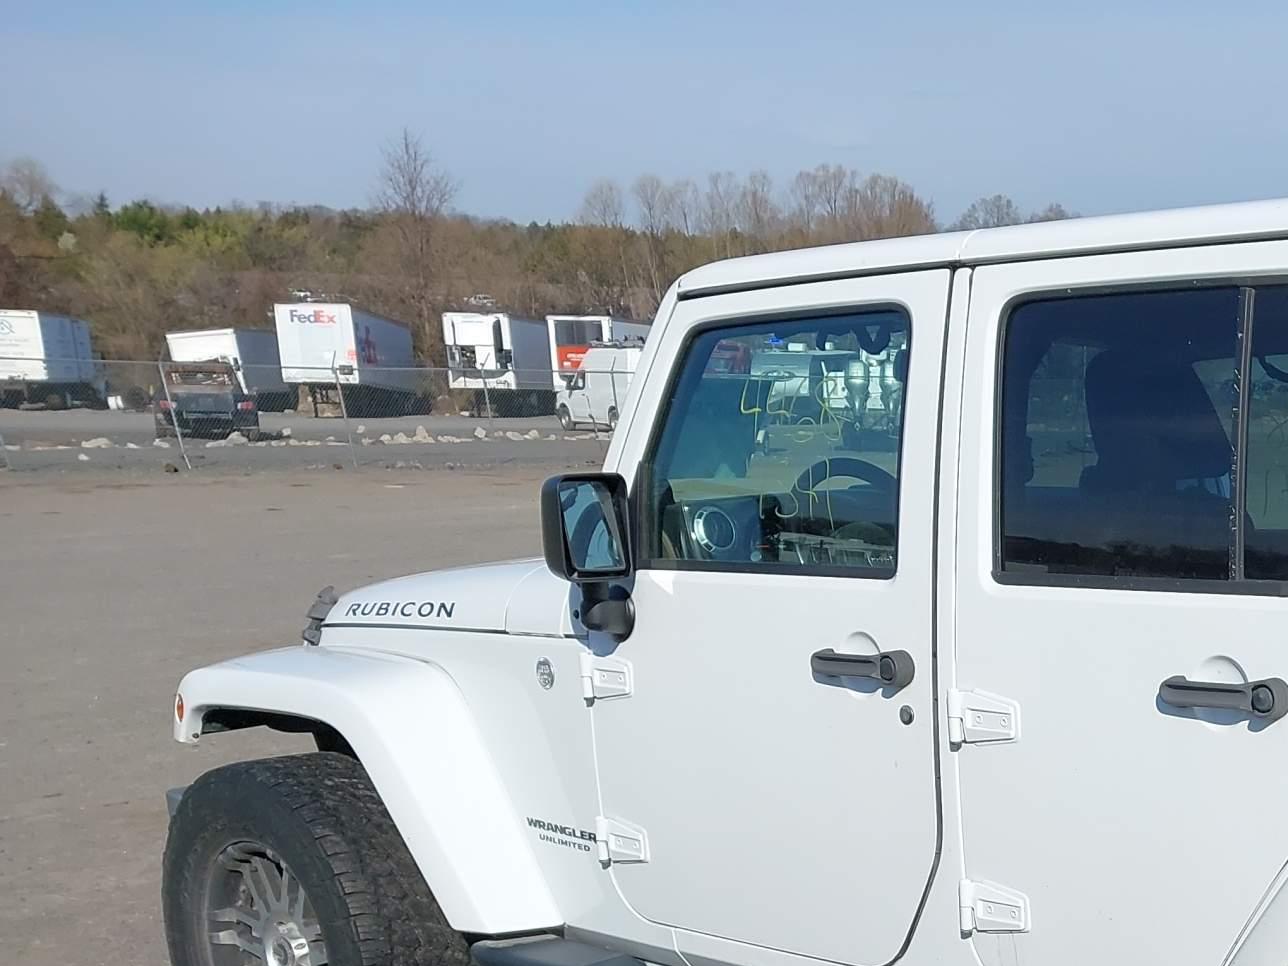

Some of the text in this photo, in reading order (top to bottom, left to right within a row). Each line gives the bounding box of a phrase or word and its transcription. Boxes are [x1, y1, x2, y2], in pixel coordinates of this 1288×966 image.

[289, 309, 336, 325] FedEx
[345, 601, 456, 619] RUBICON
[526, 816, 598, 844] WRANGLER
[539, 833, 592, 852] UNLIMITED
